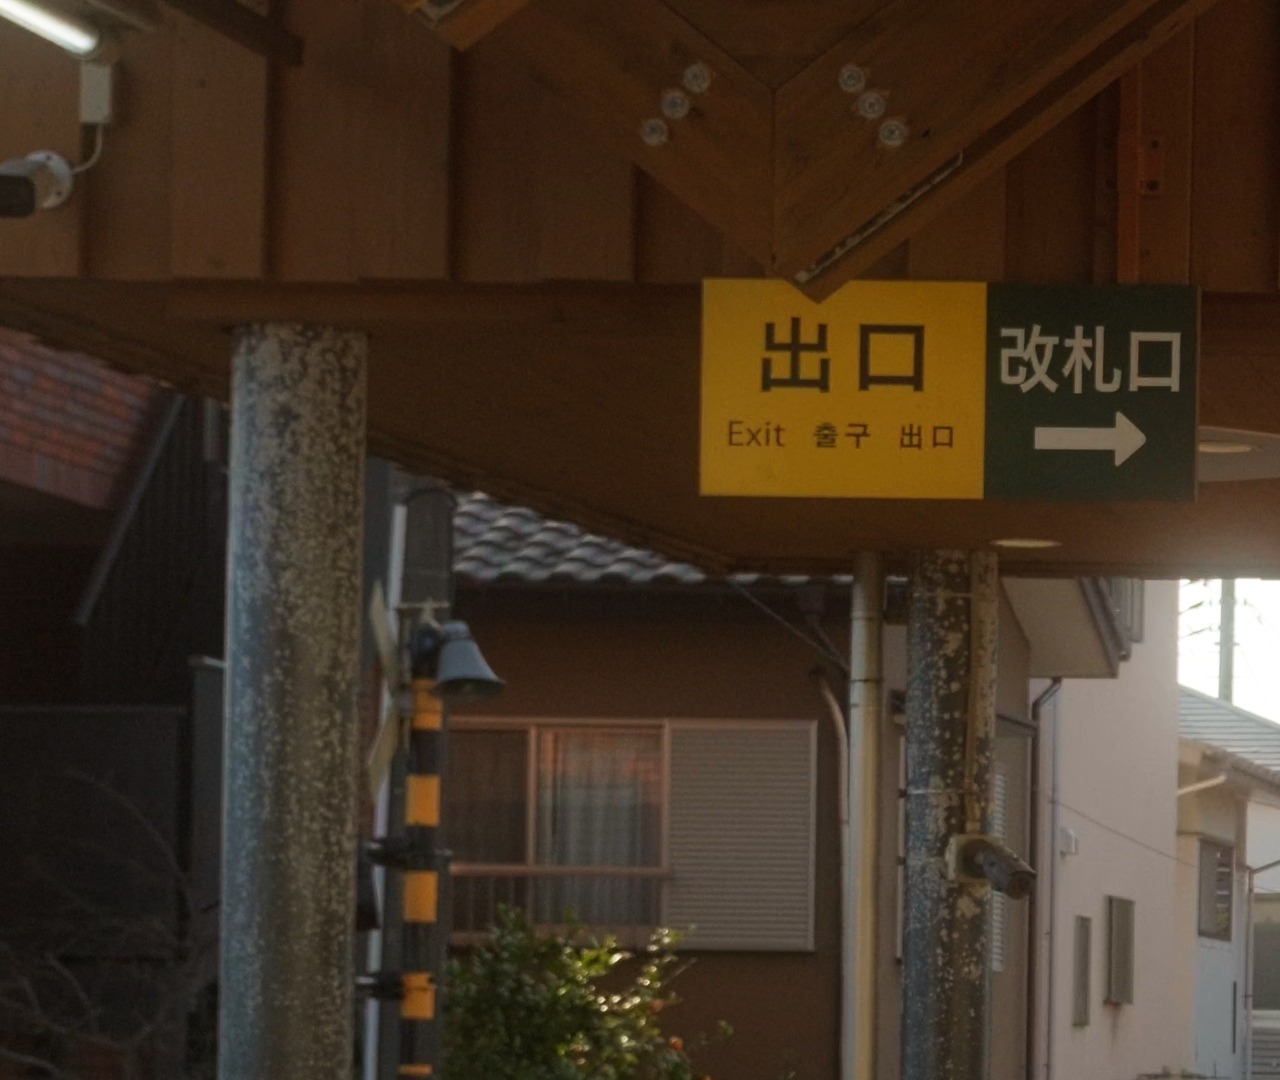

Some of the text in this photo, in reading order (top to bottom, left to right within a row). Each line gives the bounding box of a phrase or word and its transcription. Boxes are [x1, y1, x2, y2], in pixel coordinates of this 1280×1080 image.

[760, 316, 925, 393] 出口
[1000, 324, 1182, 394] 改札口
[727, 421, 955, 450] Exit 출구 出口
